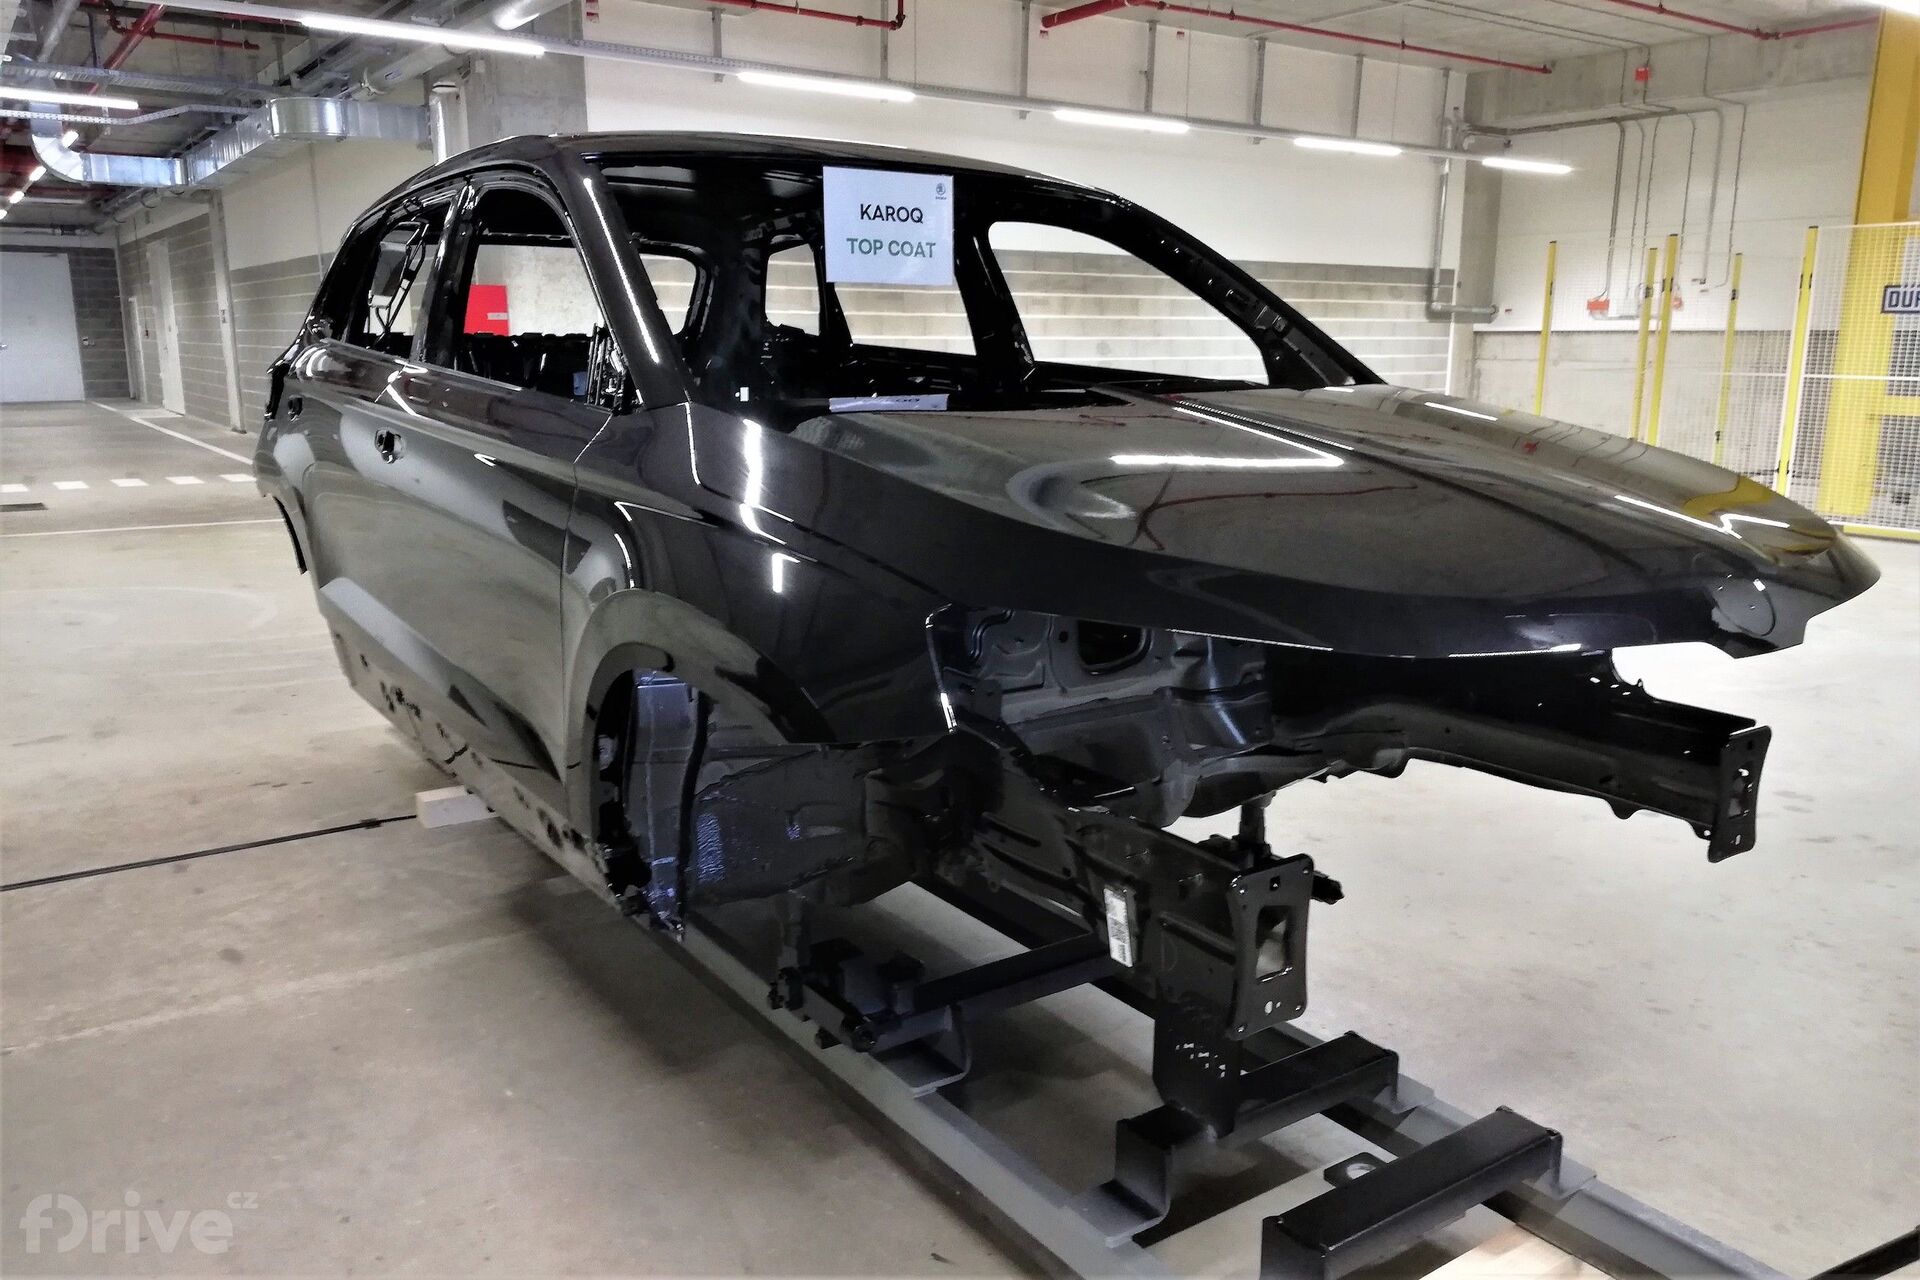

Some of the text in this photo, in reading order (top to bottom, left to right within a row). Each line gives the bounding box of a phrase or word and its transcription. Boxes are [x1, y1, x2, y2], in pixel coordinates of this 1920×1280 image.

[860, 204, 924, 224] KAROQ
[846, 238, 936, 258] TOP COAT
